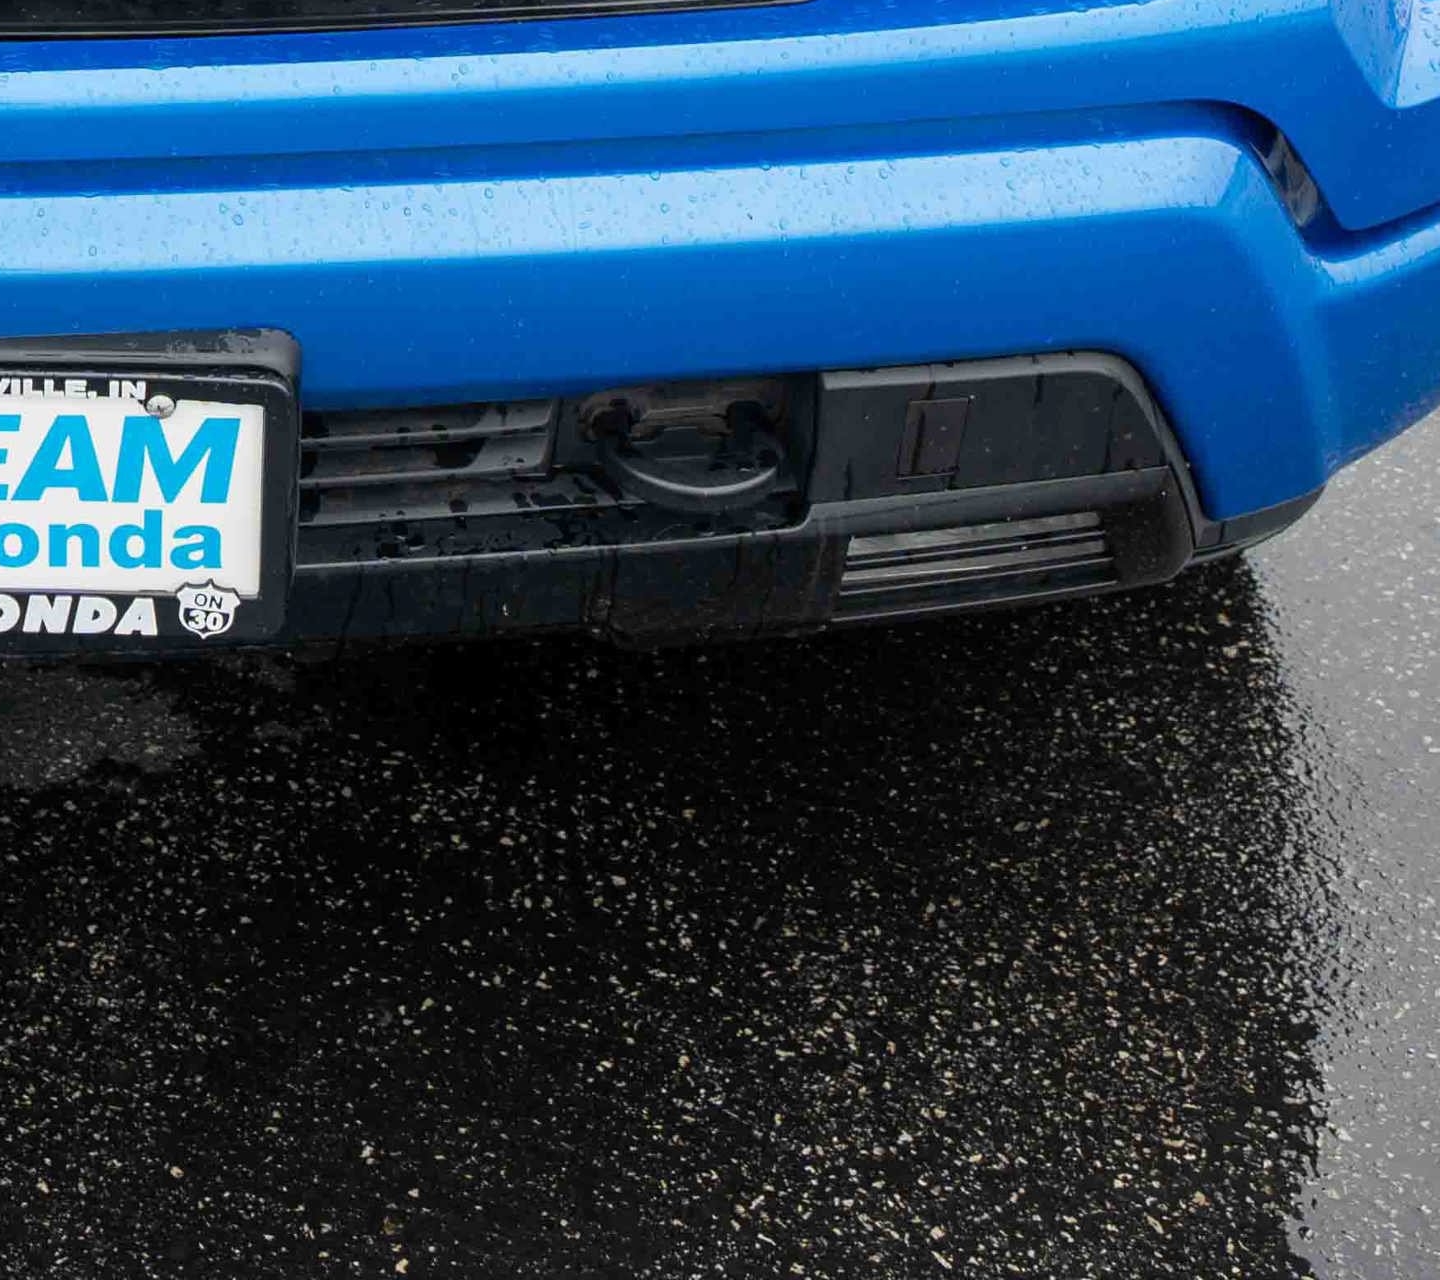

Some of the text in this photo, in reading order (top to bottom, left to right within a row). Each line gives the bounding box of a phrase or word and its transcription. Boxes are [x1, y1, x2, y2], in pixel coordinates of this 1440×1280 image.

[108, 381, 146, 400] IN
[194, 593, 224, 609] ON
[188, 609, 224, 631] 30
